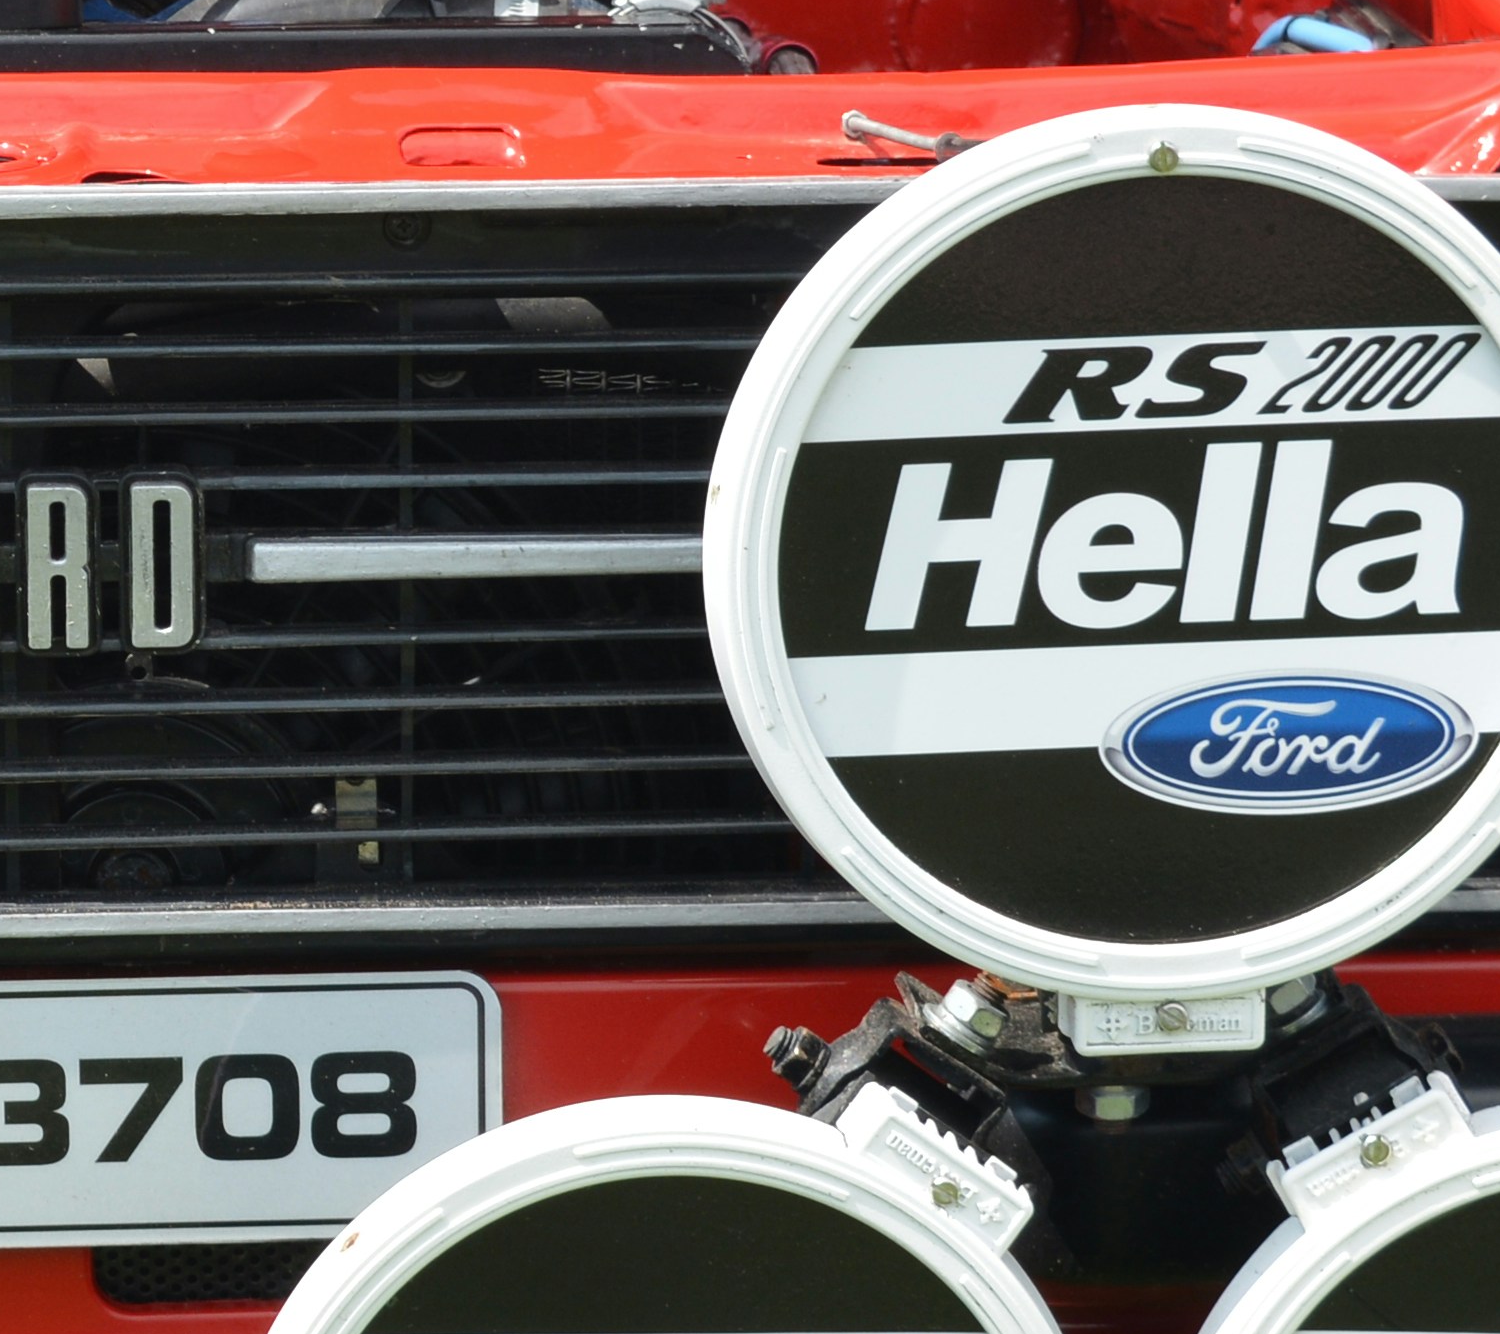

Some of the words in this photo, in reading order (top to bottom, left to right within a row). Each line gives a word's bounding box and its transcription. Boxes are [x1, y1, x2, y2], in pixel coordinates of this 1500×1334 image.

[1003, 341, 1267, 424] RS
[1258, 332, 1480, 415] 2000
[864, 440, 1464, 632] Hella
[1189, 699, 1385, 777] Ford
